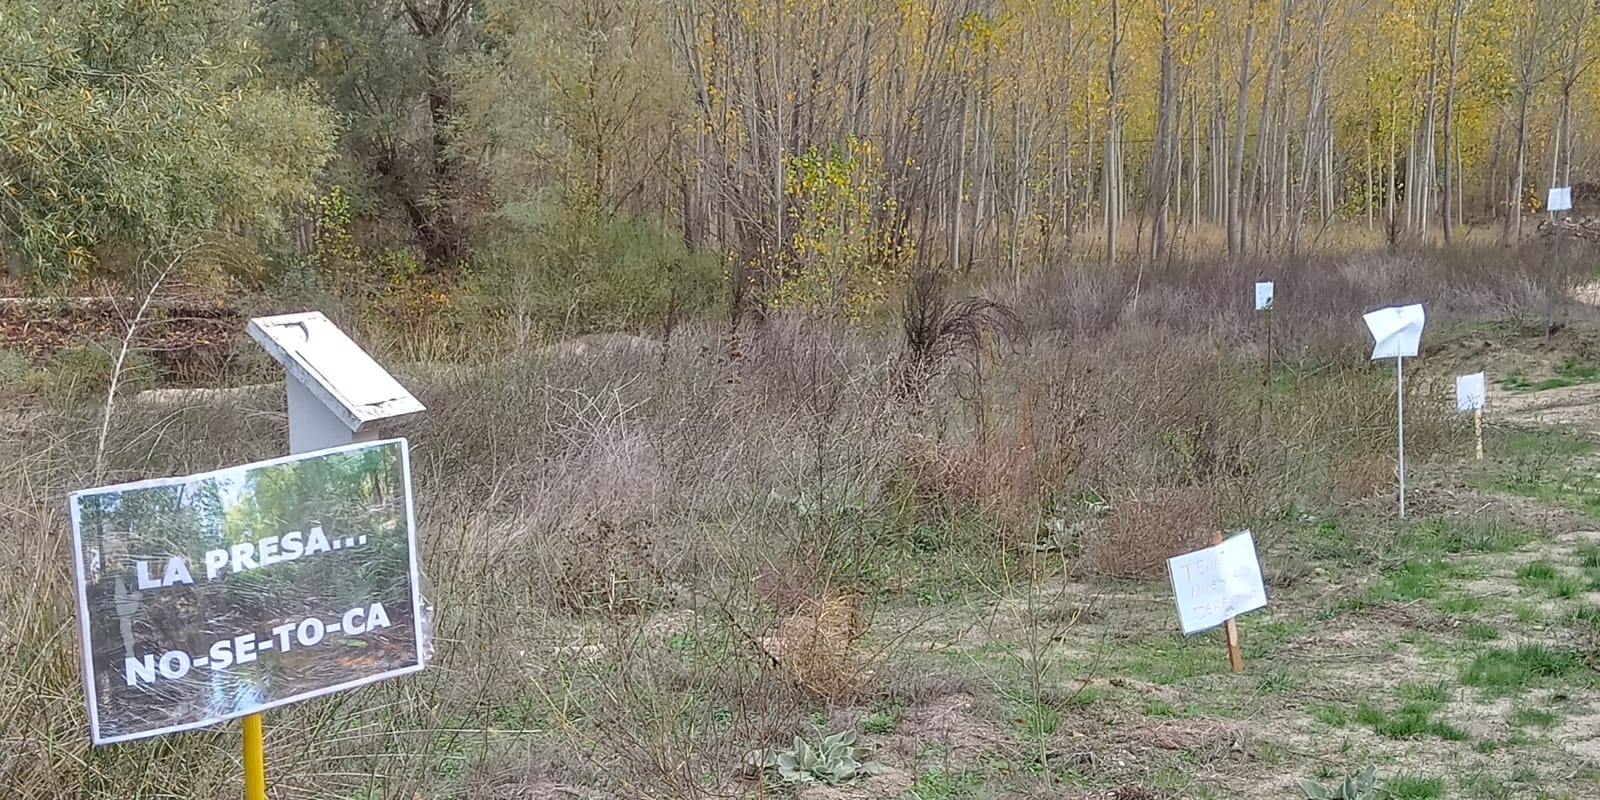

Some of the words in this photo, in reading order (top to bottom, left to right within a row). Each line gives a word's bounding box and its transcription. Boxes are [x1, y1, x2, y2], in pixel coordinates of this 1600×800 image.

[135, 557, 194, 591] LA
[205, 525, 367, 580] PRESA...
[124, 602, 392, 687] NO-SE-TO-CA
